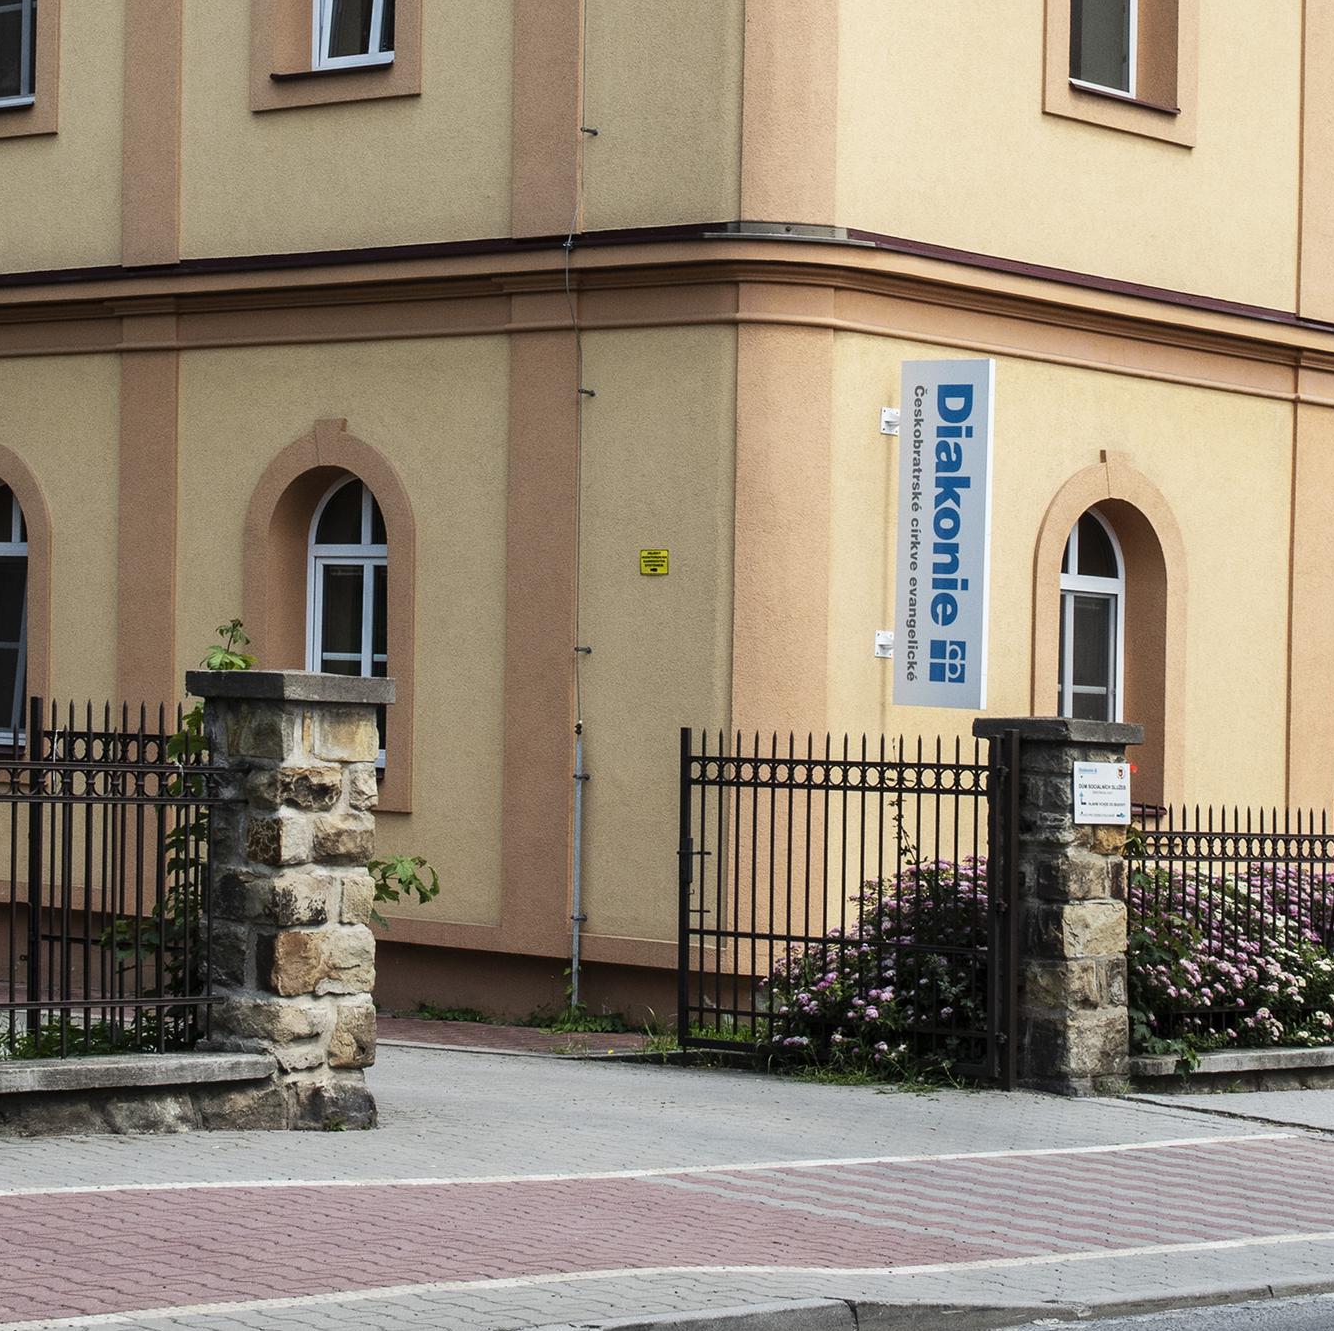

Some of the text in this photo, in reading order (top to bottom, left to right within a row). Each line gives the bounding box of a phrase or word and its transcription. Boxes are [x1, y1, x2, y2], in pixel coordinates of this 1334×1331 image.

[906, 385, 929, 682] Českobratrské církve evangelické
[931, 383, 975, 627] Diakonie
